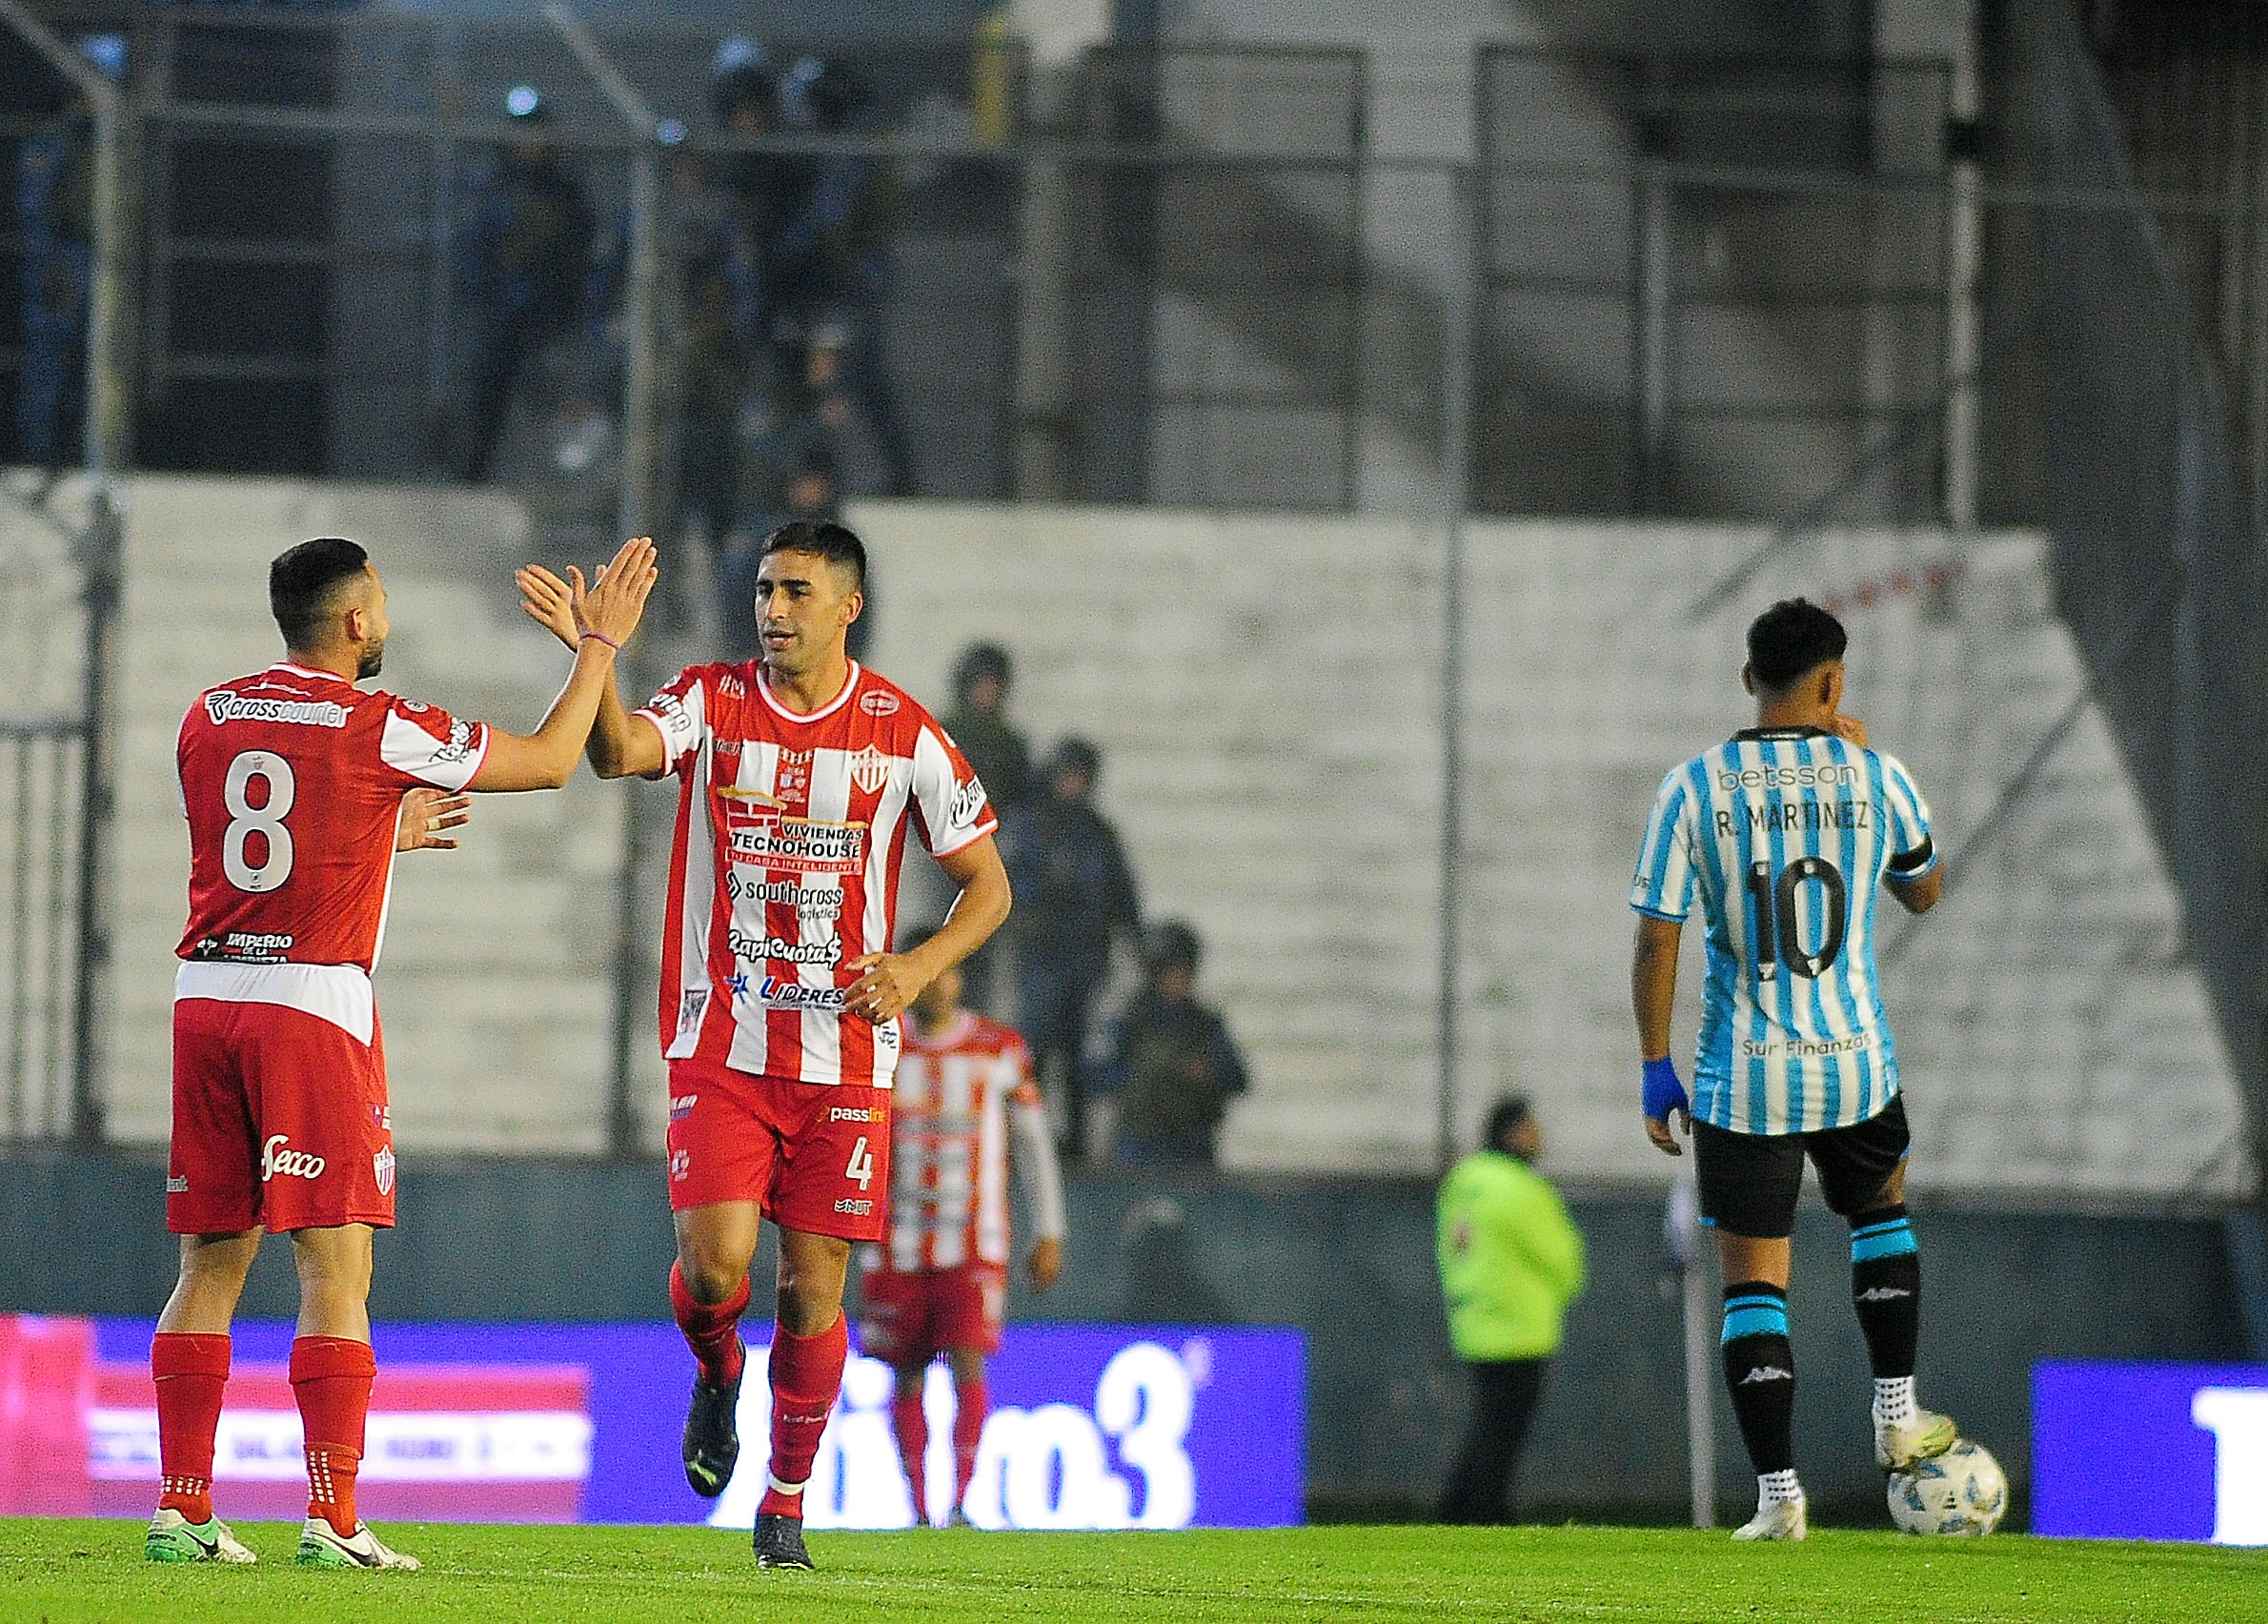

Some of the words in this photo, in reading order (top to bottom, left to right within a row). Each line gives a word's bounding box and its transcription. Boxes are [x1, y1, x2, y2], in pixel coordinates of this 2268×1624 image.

[1717, 764, 1858, 791] betsson
[223, 750, 295, 892] 8
[783, 824, 863, 841] VIVIENDAS
[1715, 810, 1740, 838] R.
[1747, 801, 1868, 832] MARTINEZ
[731, 832, 860, 858] TECNOHOUSE
[745, 881, 842, 905] southcross
[1748, 856, 1847, 983] 10
[226, 933, 293, 948] IMPERIO
[1742, 1039, 1778, 1056] Sur
[1786, 1033, 1872, 1056] Finanzas
[845, 1136, 873, 1191] 4
